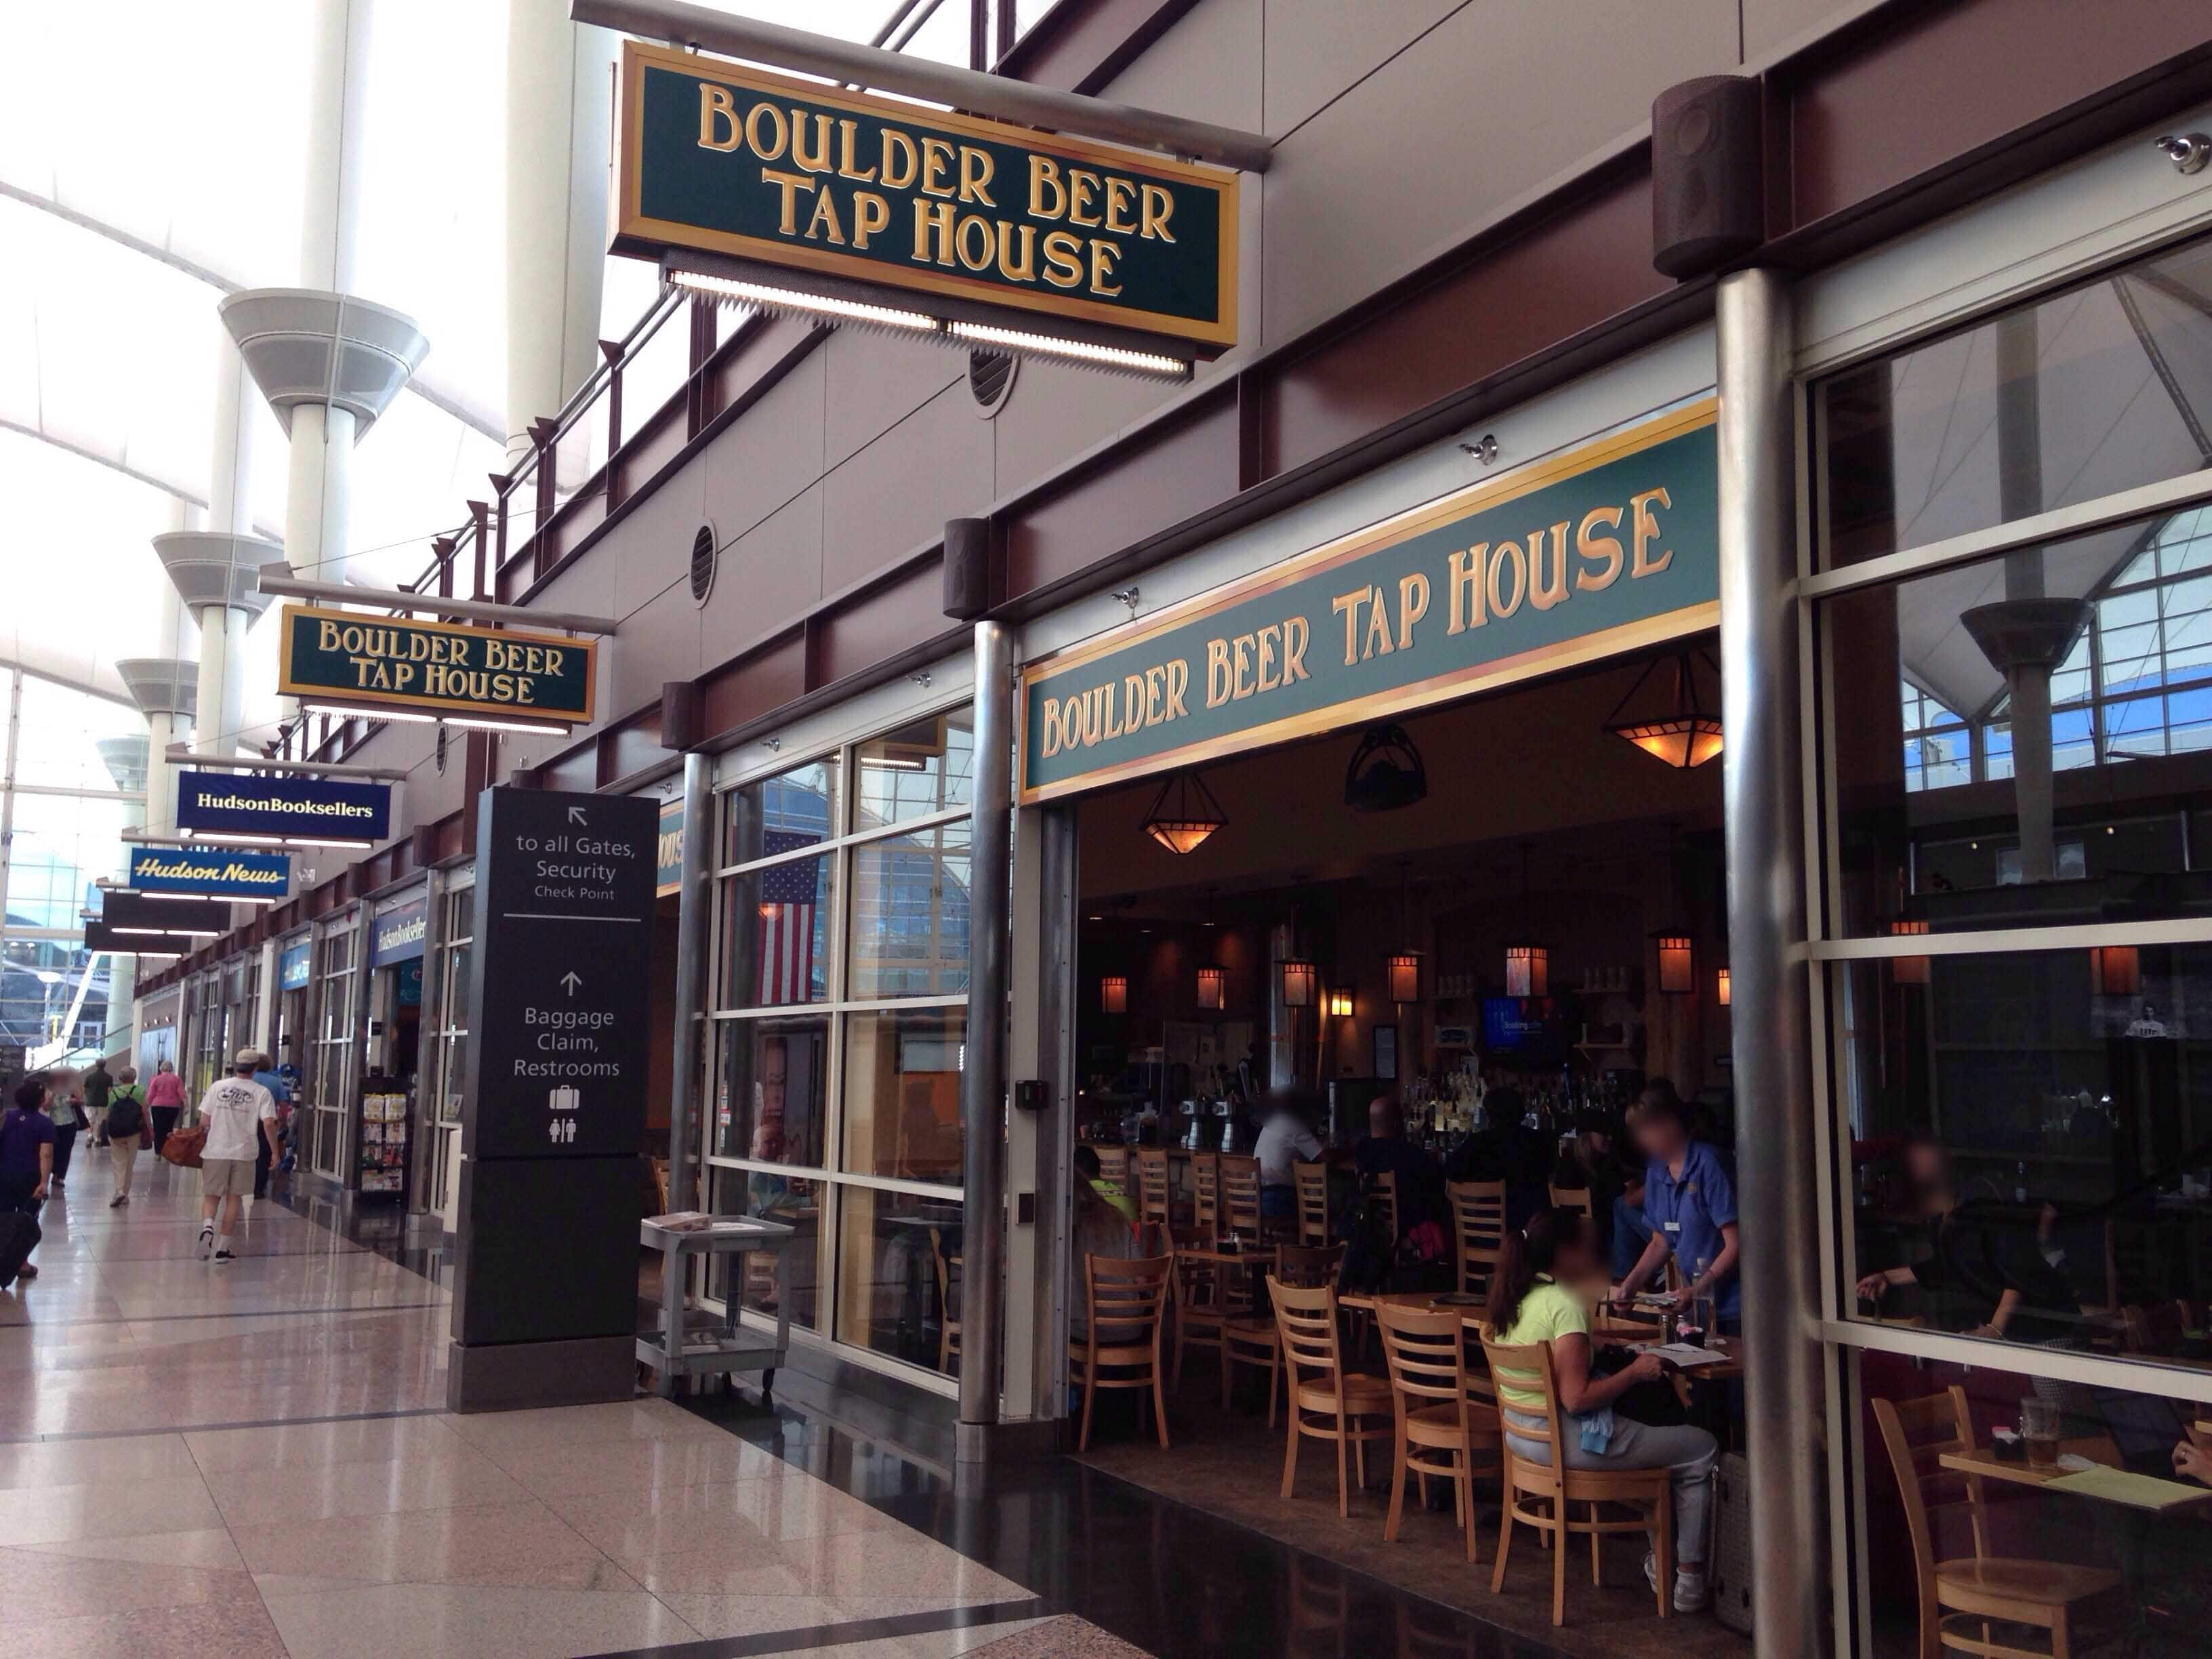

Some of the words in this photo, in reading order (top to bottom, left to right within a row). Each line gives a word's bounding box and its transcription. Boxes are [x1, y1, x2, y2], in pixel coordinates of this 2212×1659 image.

[697, 83, 996, 209] BOULDER
[1027, 155, 1177, 244] BEER
[762, 167, 890, 249] TAP
[912, 197, 1124, 298] HOUSE
[1042, 659, 1191, 759] BOULDER
[1206, 615, 1311, 709] BEER
[1332, 571, 1431, 666] TAP
[1448, 487, 1675, 636] HOUSE
[319, 620, 469, 667] BOULDER
[485, 639, 564, 676] BEER
[350, 657, 414, 690] TAP
[424, 664, 535, 704] HOUSE
[516, 835, 538, 851] to
[545, 836, 568, 853] all
[576, 838, 635, 859] Gates,
[135, 858, 220, 880] Hudson
[221, 863, 286, 883] News
[537, 860, 616, 884] Security
[535, 885, 575, 899] Check
[580, 887, 614, 900] Point
[525, 1007, 615, 1029] Baggage
[537, 1033, 598, 1052] Claim,
[514, 1059, 620, 1076] Restrooms
